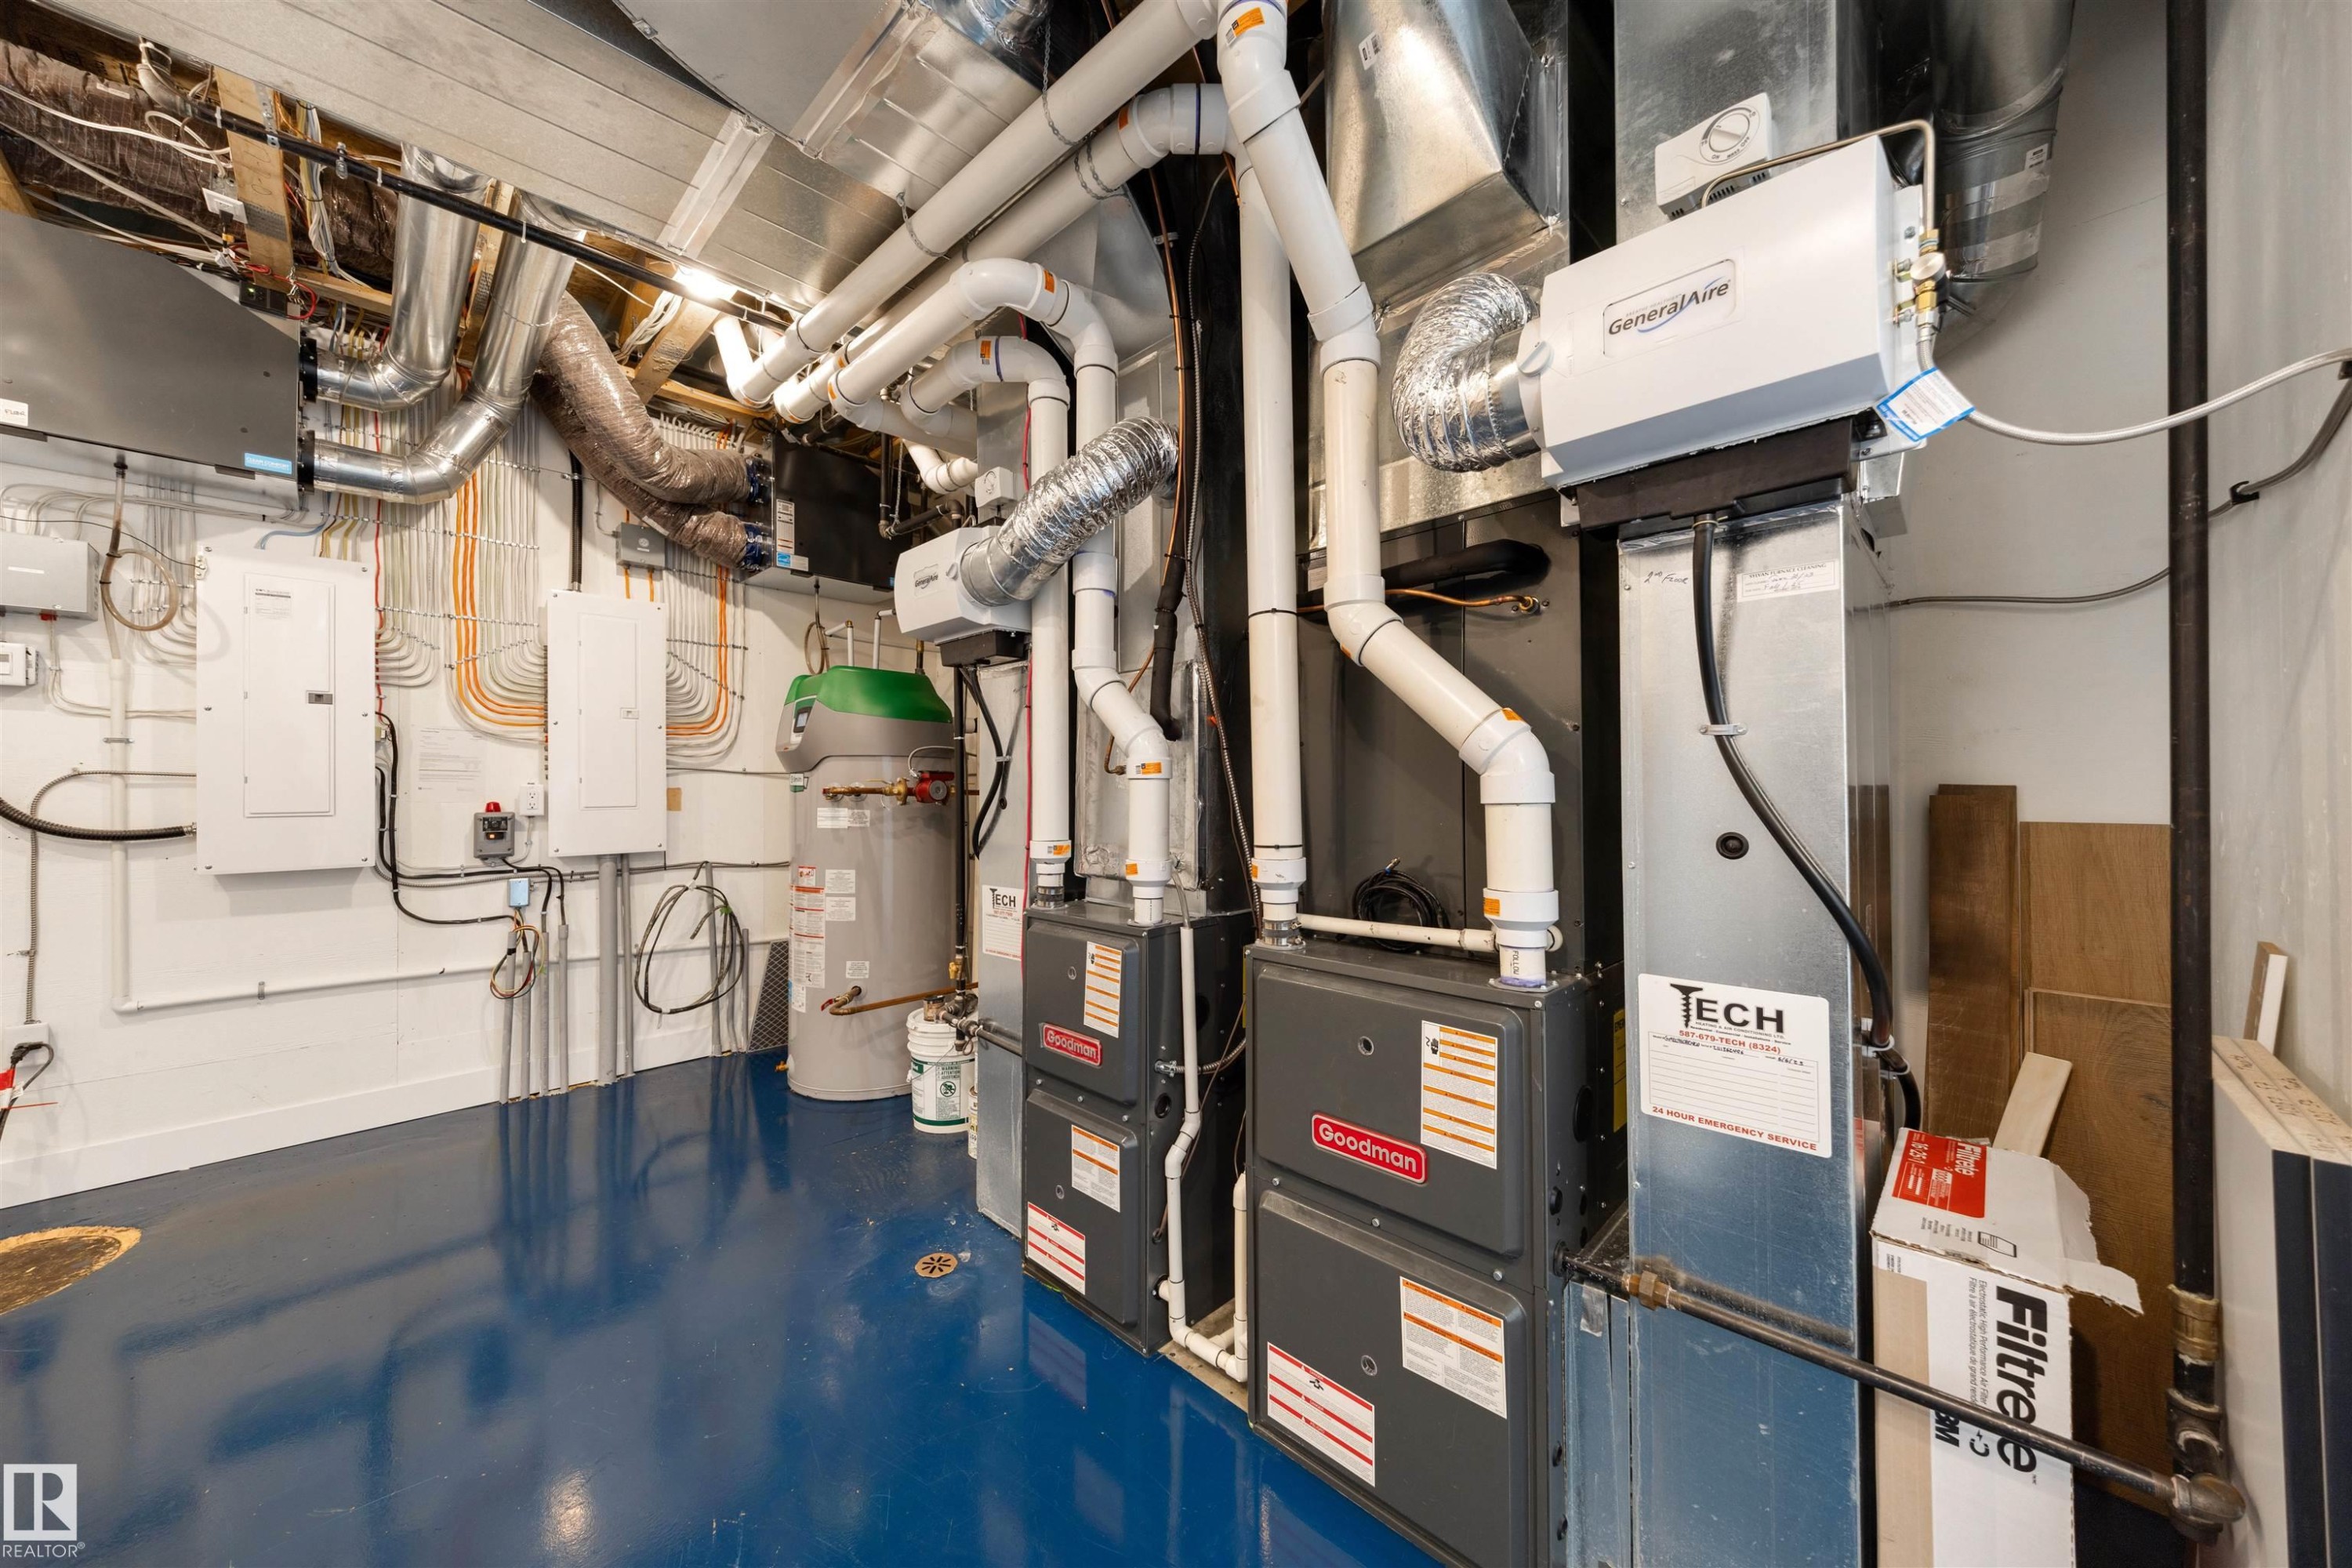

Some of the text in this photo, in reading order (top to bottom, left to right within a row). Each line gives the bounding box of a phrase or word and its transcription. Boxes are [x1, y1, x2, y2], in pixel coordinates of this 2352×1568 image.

[989, 887, 1016, 909] TECH
[1669, 982, 1784, 1034] TECH
[1047, 1029, 1097, 1058] Goodman
[1679, 1029, 1746, 1047] 587-679-TECH
[1748, 1042, 1781, 1054] (8324)
[1652, 1105, 1817, 1151] 24 HOUR EMERGENCY SERVICE
[1319, 1123, 1417, 1173] Goodman
[1969, 1276, 1977, 1293] Filtre
[1969, 1299, 1977, 1308] air
[1978, 1279, 1989, 1405] Electrostatic High Performance Air Filter
[1969, 1356, 1978, 1365] de
[1968, 1366, 1978, 1386] grand
